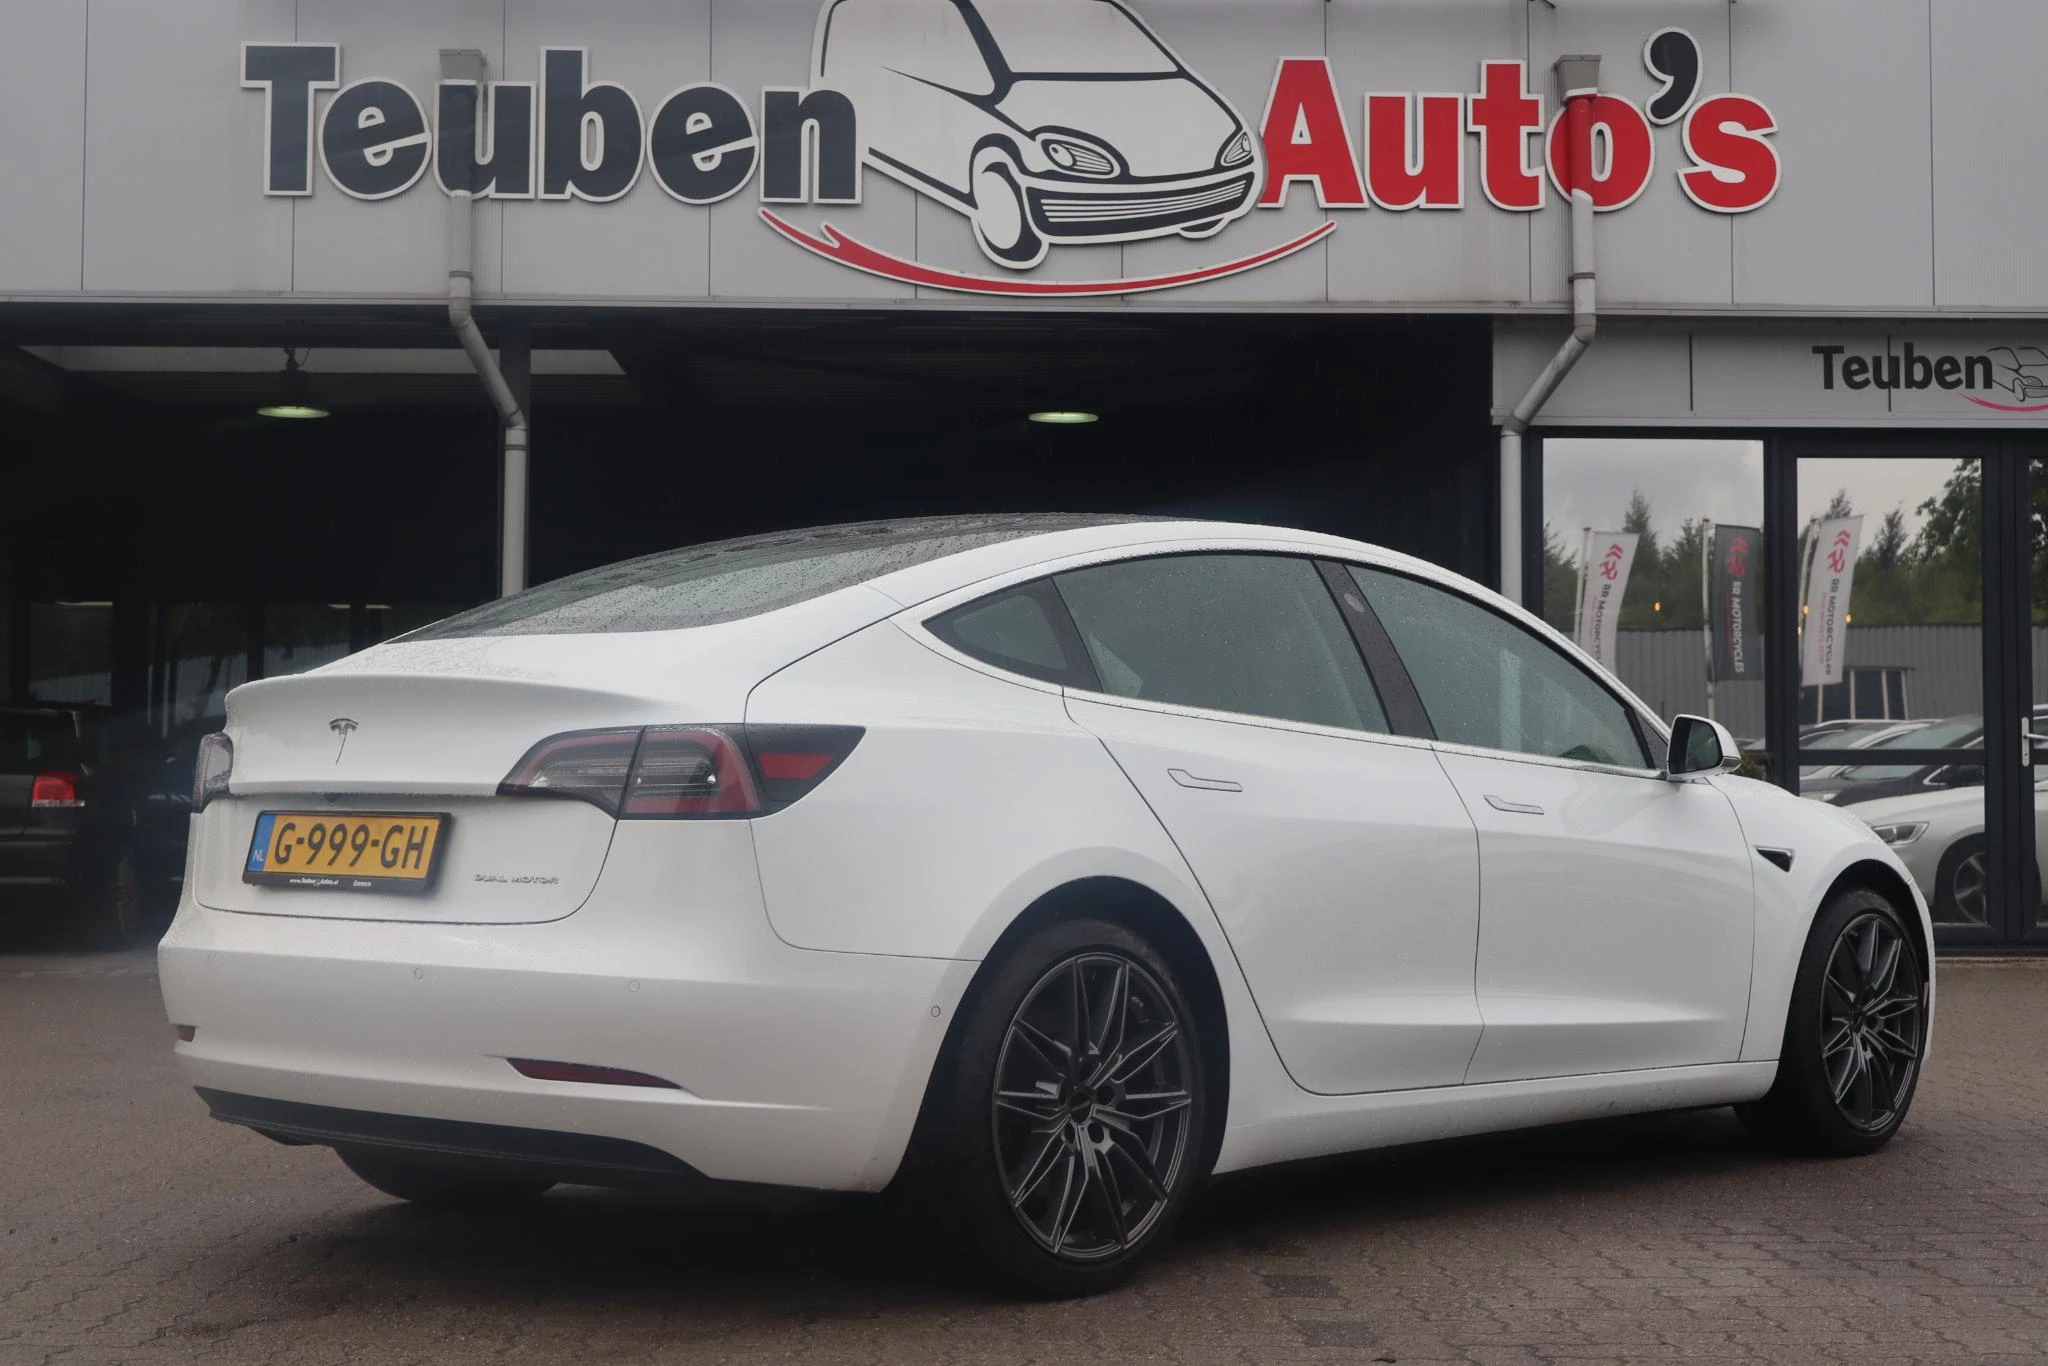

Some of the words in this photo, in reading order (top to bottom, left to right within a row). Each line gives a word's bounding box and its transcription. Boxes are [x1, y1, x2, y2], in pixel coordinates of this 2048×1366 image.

[241, 41, 862, 204] Teuben
[1257, 27, 1781, 213] Auto's
[1811, 341, 1993, 390] Teuben
[1732, 581, 1742, 595] RR
[1830, 578, 1840, 593] RR
[1731, 597, 1745, 673] MOTORCYCLES
[1825, 596, 1837, 676] MOTORCYCLES
[252, 850, 265, 862] NL
[274, 822, 429, 870] G-999-GH
[474, 873, 508, 883] DUAL
[511, 875, 560, 885] MOTOR
